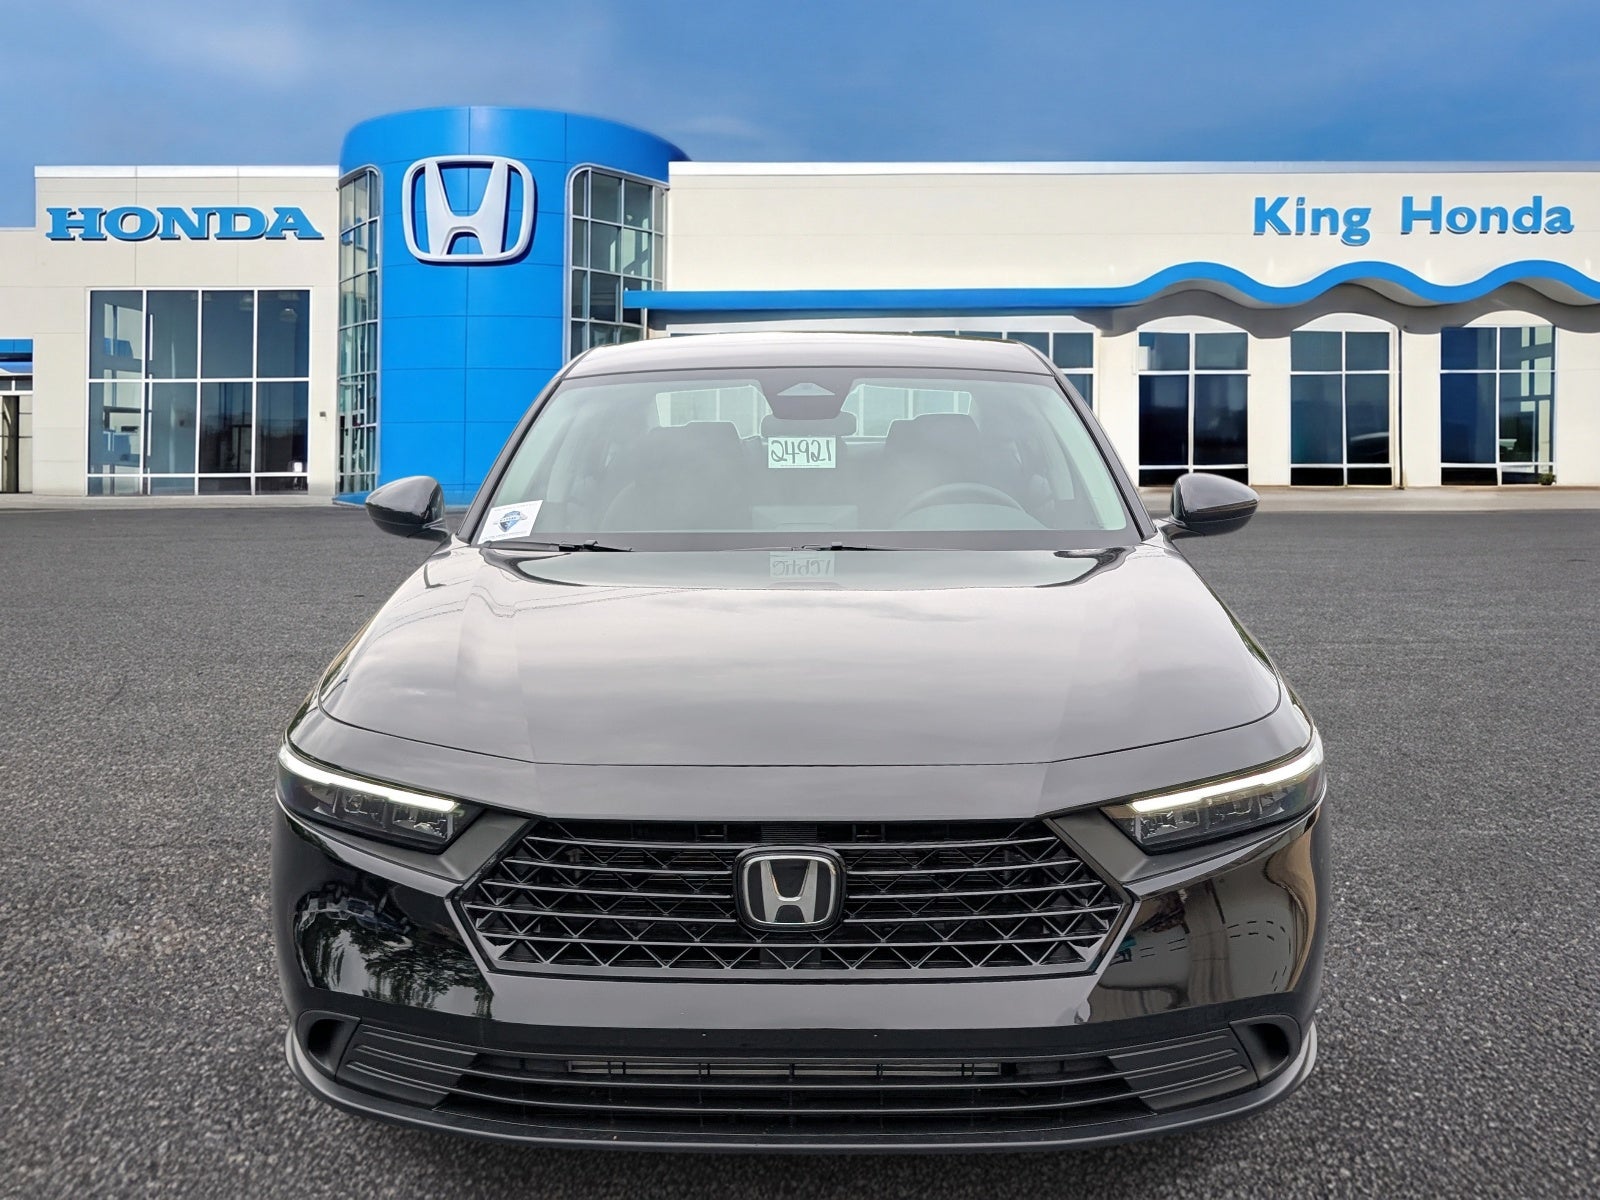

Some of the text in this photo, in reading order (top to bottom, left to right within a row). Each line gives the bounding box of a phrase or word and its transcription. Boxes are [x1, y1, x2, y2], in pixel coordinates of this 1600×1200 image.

[46, 206, 325, 240] HONDA
[1253, 195, 1575, 247] King Honda
[770, 439, 832, 464] 24921
